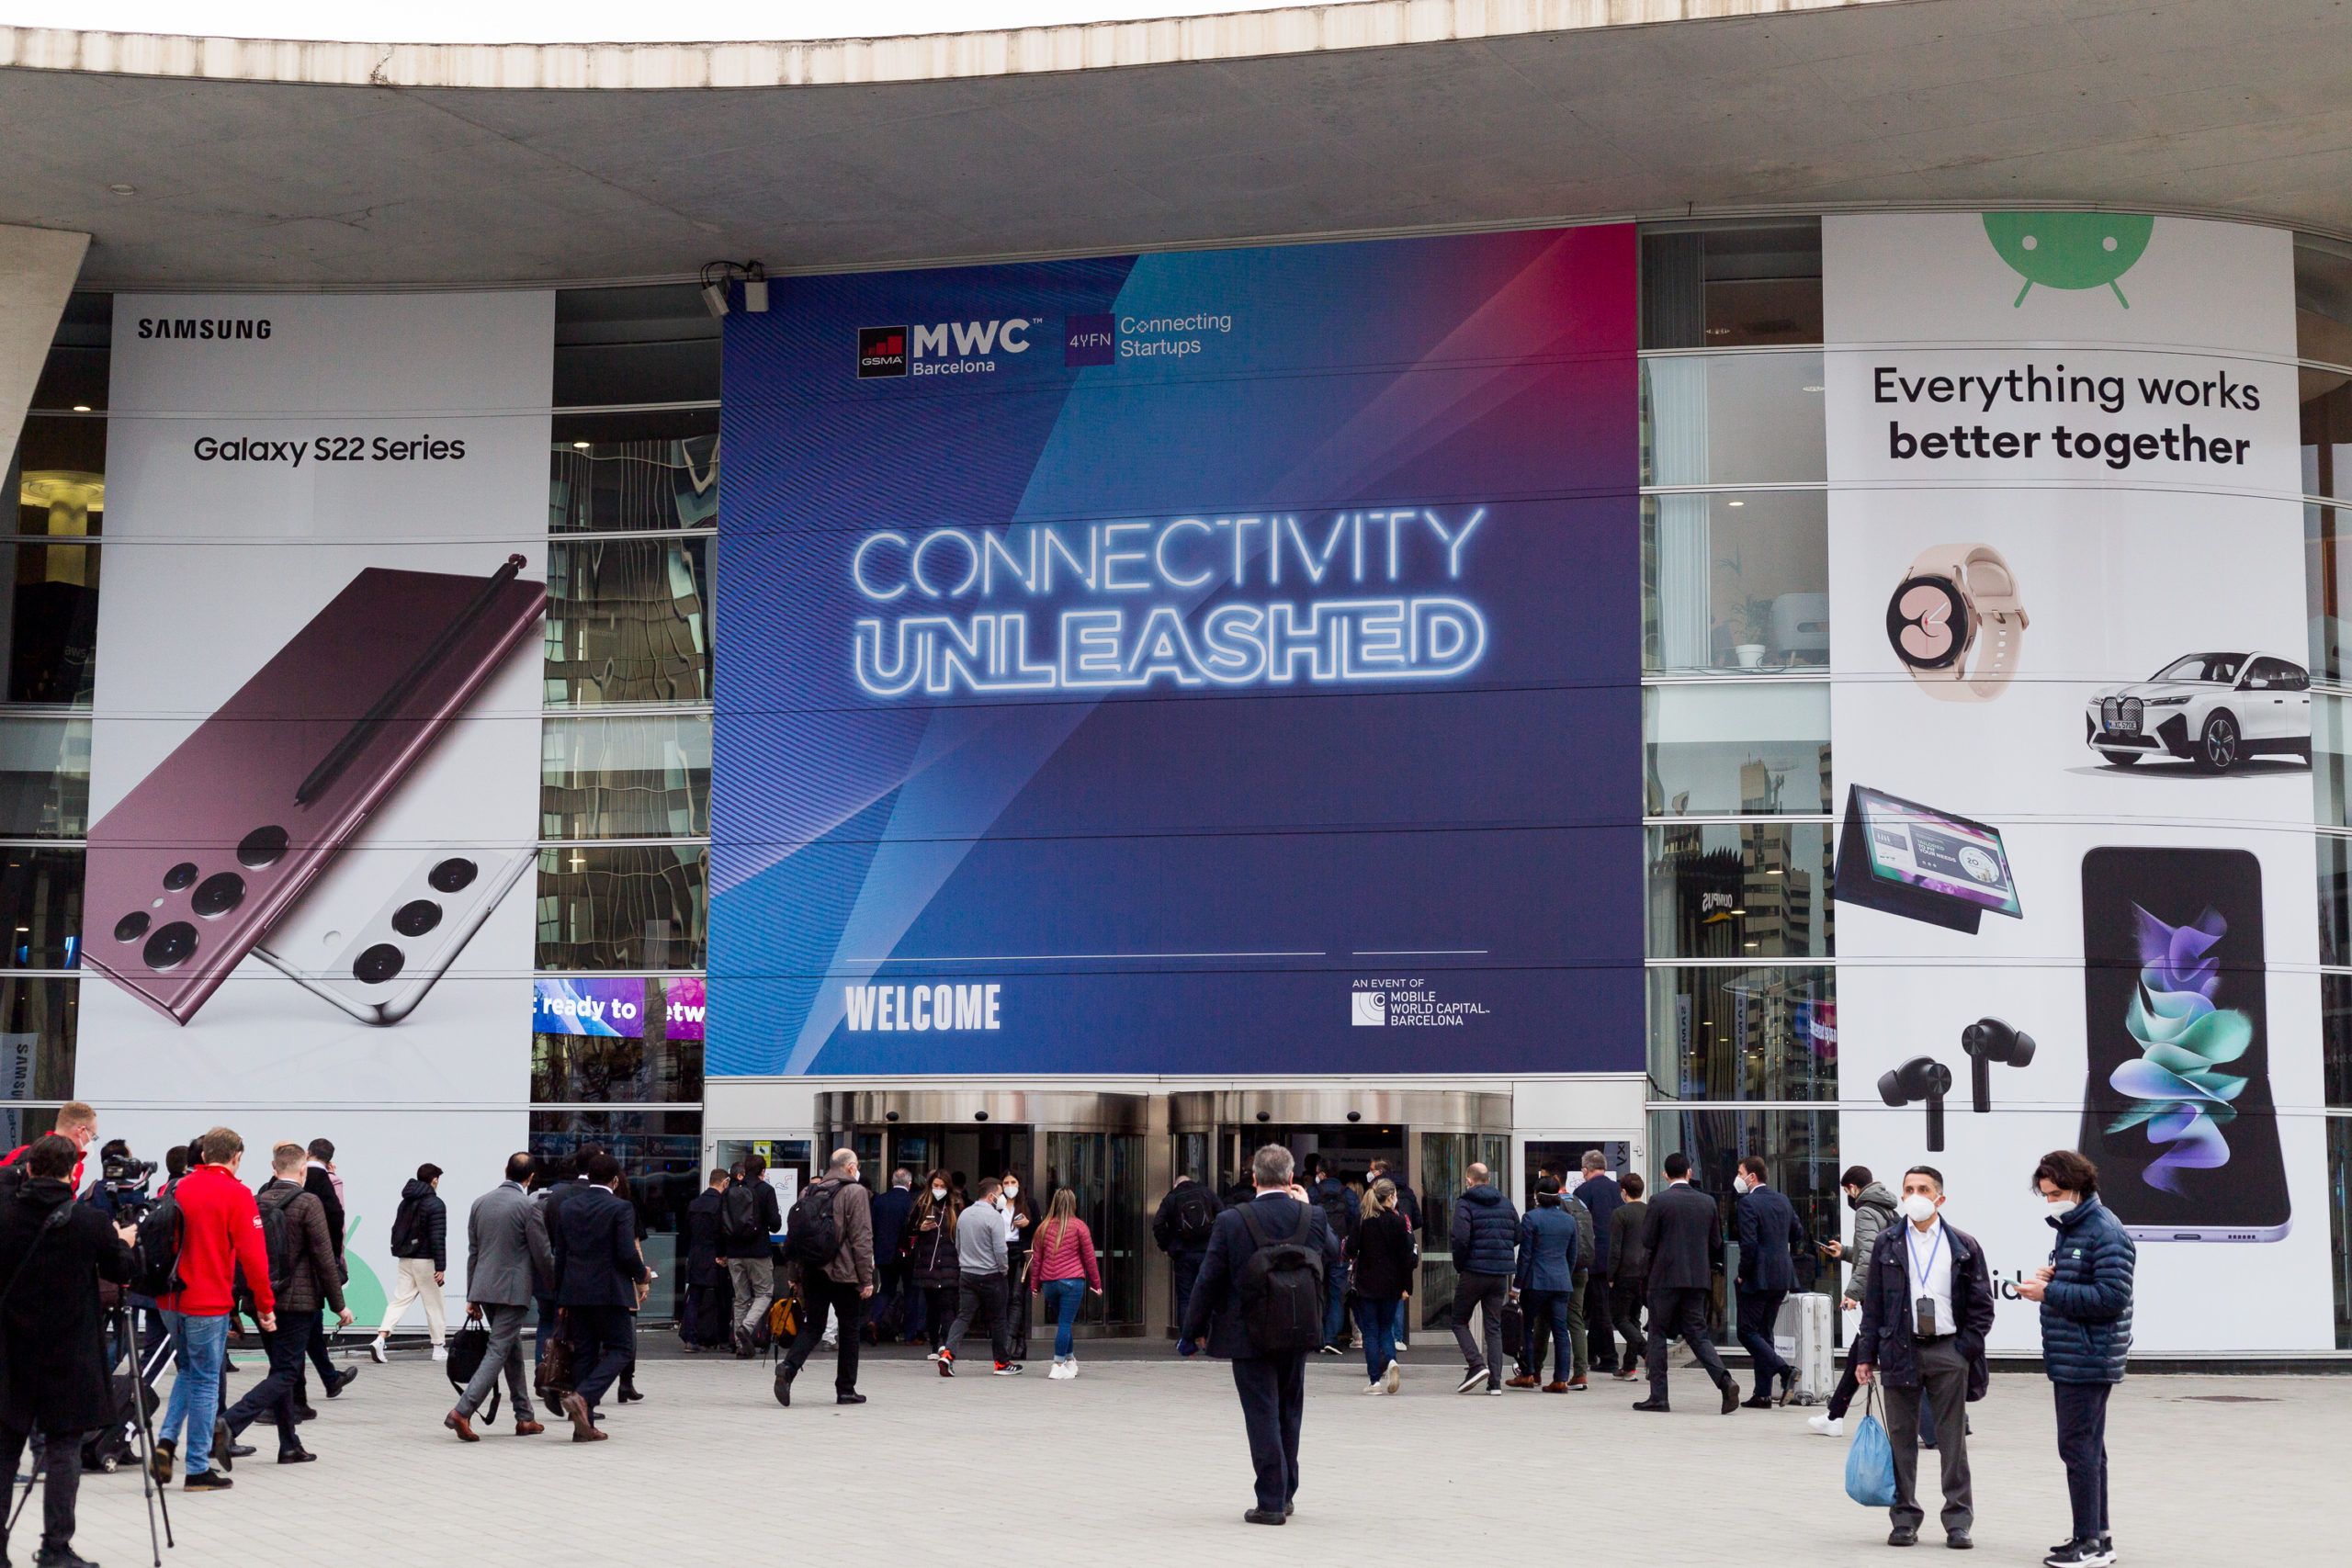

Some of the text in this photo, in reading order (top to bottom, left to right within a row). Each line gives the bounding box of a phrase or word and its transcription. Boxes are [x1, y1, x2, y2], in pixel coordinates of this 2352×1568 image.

[138, 318, 271, 340] SAMSUNG
[1120, 312, 1232, 334] Connecting
[1069, 333, 1111, 347] 4YFN
[1120, 337, 1202, 358] Startups
[861, 355, 902, 366] GSMA
[912, 359, 996, 376] Barcelona
[1874, 364, 2261, 413] Everything works
[194, 434, 466, 468] Galaxy S22 Series
[1890, 421, 2251, 470] better together
[854, 507, 1486, 600] CONNECTIVITY
[854, 598, 1487, 695] UNLEASHED
[1352, 978, 1425, 988] AN EVENT OF
[1391, 991, 1436, 1002] MOBILE
[543, 996, 605, 1021] ready
[611, 998, 637, 1020] to
[845, 984, 1001, 1032] WELCOME
[1390, 1003, 1433, 1014] WORLD
[1391, 1015, 1464, 1026] BARCELONA
